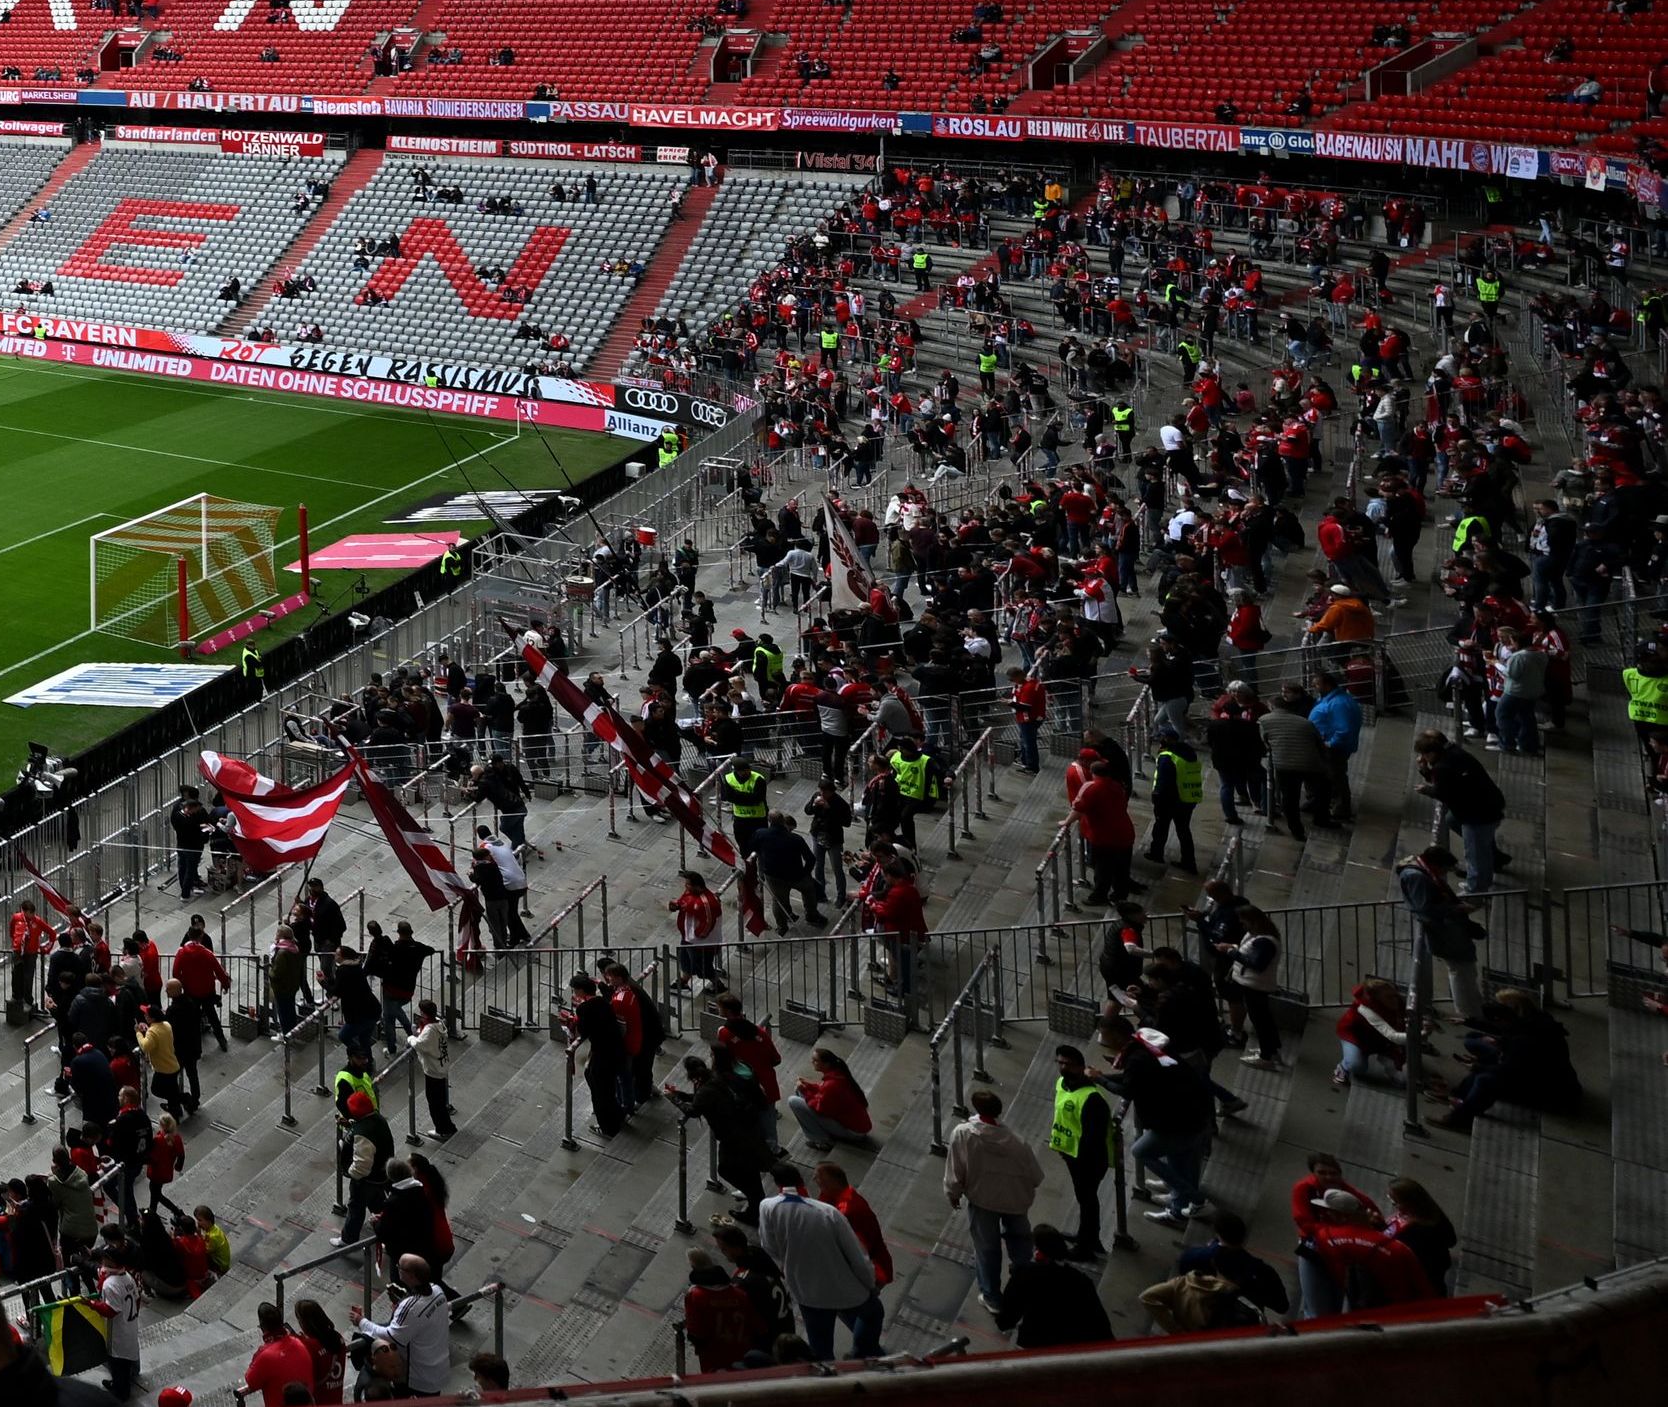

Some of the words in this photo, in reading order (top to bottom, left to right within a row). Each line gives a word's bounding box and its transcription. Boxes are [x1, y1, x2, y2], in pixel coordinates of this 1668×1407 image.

[22, 90, 77, 101] MARKELSHEIM
[129, 92, 156, 109] AU
[313, 99, 381, 116] Riemsloh
[384, 98, 424, 116] BAVARIA
[426, 99, 524, 119] SÜDNIEDERSACHSEN
[549, 102, 630, 119] PASSAU
[632, 109, 775, 128] HAVELMACHT
[782, 109, 895, 132] Spreewaldgurken
[949, 115, 1022, 138] RÖSLAU
[117, 126, 216, 142] Sandharlanden
[222, 129, 323, 145] HOTZENWALD
[1027, 120, 1051, 137] RED
[1051, 121, 1088, 139] WHITE
[1136, 126, 1238, 152] TAUBERTAL
[242, 141, 300, 157] HÄNNER
[391, 137, 497, 154] KLEINOSTHEIM
[510, 139, 575, 157] SÜDTIROL
[584, 144, 636, 159] LATSCH
[1315, 133, 1403, 161] RABENAU/SN
[1405, 138, 1470, 169] MAHL
[2, 314, 33, 335] FC
[43, 318, 137, 346] BAYERN
[61, 345, 76, 361] T
[92, 348, 193, 377] UNLIMITED
[219, 337, 281, 362] ROT
[289, 347, 374, 378] GEGEN
[210, 363, 275, 390] DATEN
[278, 370, 339, 398] OHNE
[340, 374, 500, 411] SCHLUSSPFIFF
[607, 415, 658, 438] Allianz
